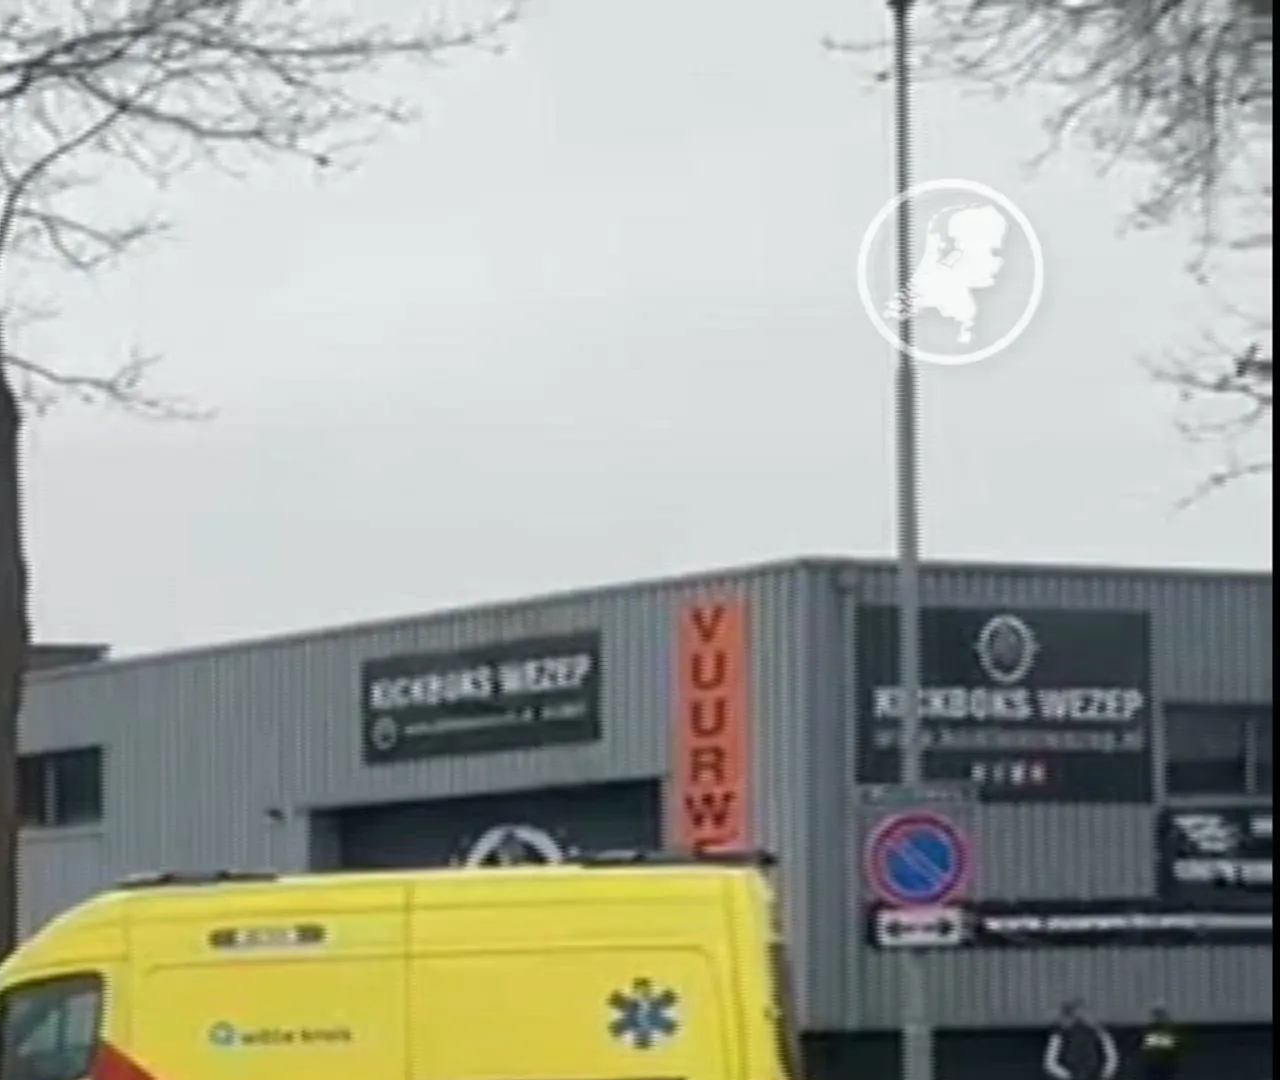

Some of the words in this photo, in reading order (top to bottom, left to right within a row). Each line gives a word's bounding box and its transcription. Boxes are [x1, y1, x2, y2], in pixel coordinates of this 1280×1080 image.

[370, 664, 493, 709] KICKBOKS
[498, 654, 591, 693] WEZEP
[1038, 686, 1143, 721] WEZEP
